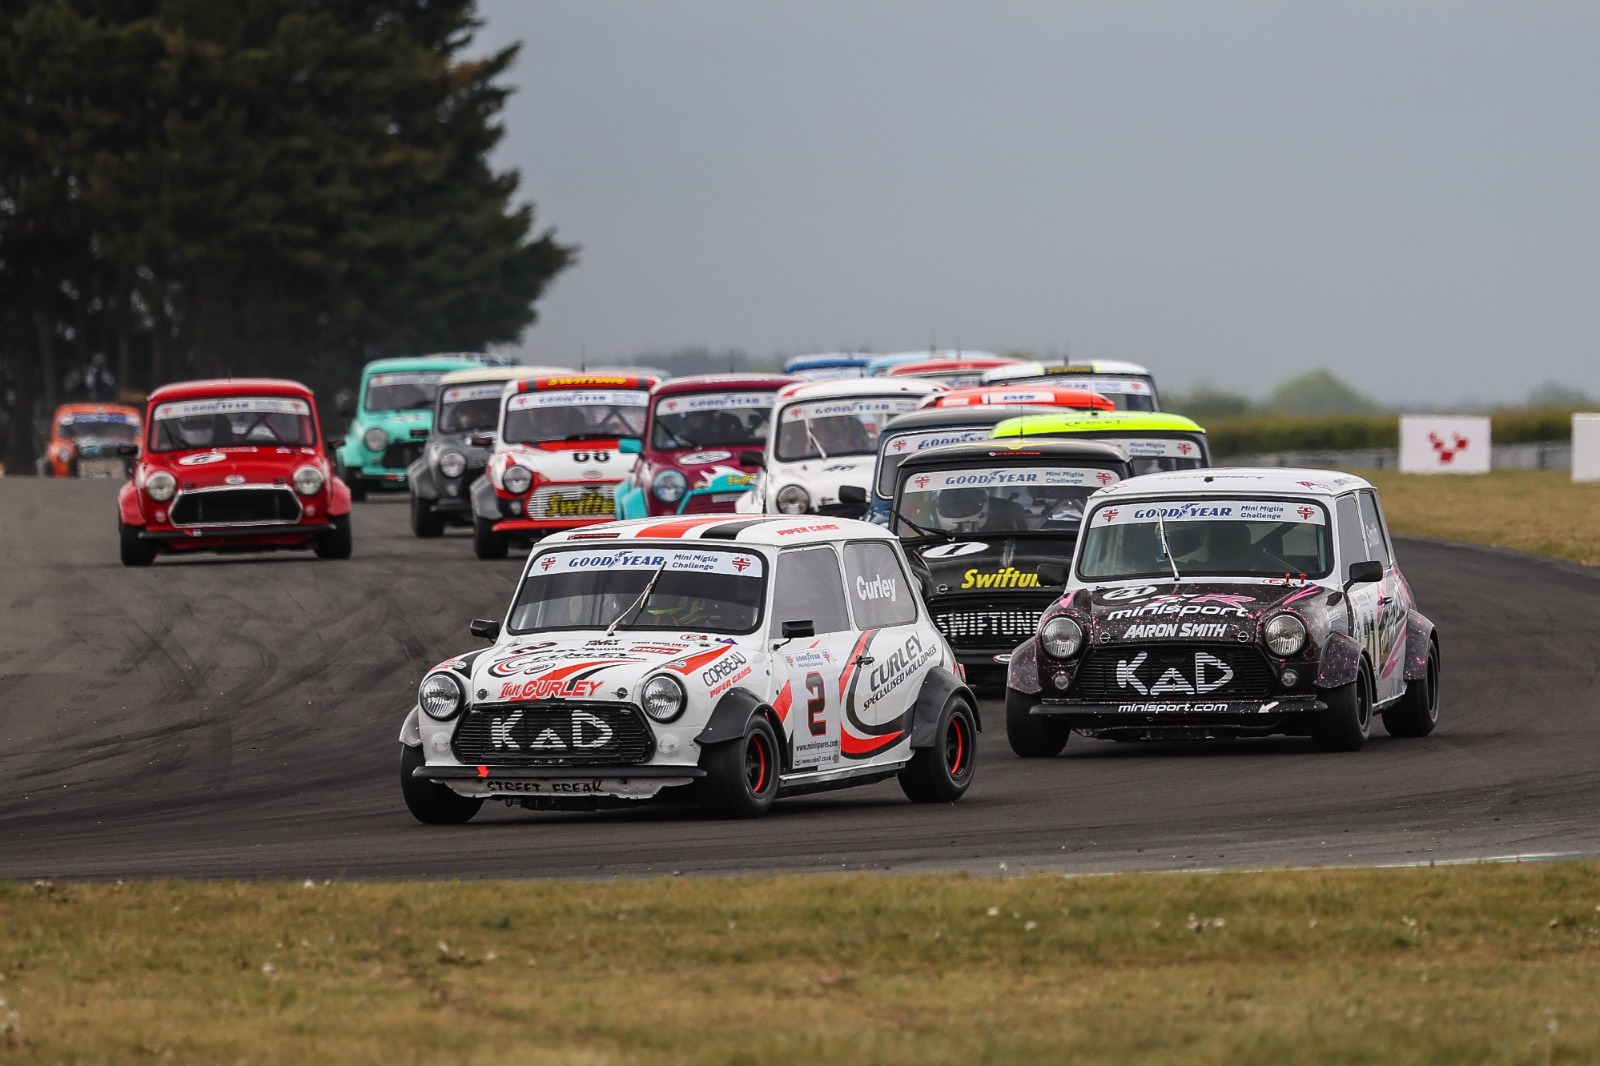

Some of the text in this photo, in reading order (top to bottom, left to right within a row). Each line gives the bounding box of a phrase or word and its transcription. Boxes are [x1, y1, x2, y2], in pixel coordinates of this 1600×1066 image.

[945, 470, 1037, 485] GOODYEAR
[1046, 477, 1083, 485] Challenge
[1062, 471, 1084, 479] Miglia
[1134, 503, 1233, 519] GOODYEAR
[1240, 504, 1284, 513] Mini Miglia
[1240, 512, 1282, 520] Challenge
[776, 524, 840, 536] PIPER CAMS
[568, 551, 664, 569] GOODYEAR
[671, 561, 715, 571] Challenge
[673, 553, 719, 563] Mini Miglia
[856, 573, 897, 602] Curley
[1107, 604, 1249, 621] minisport
[1123, 622, 1228, 639] AARON SMITH
[702, 652, 747, 688] CORBEAU
[870, 631, 923, 693] CURLEY
[709, 666, 753, 699] PIPER CAMS
[863, 643, 937, 712] SPECIALISED MOULDINGS
[498, 680, 605, 699] Ian CURLEY
[805, 670, 827, 737] 2
[1118, 702, 1229, 714] minisport.com
[486, 780, 604, 793] STREET FREAK
